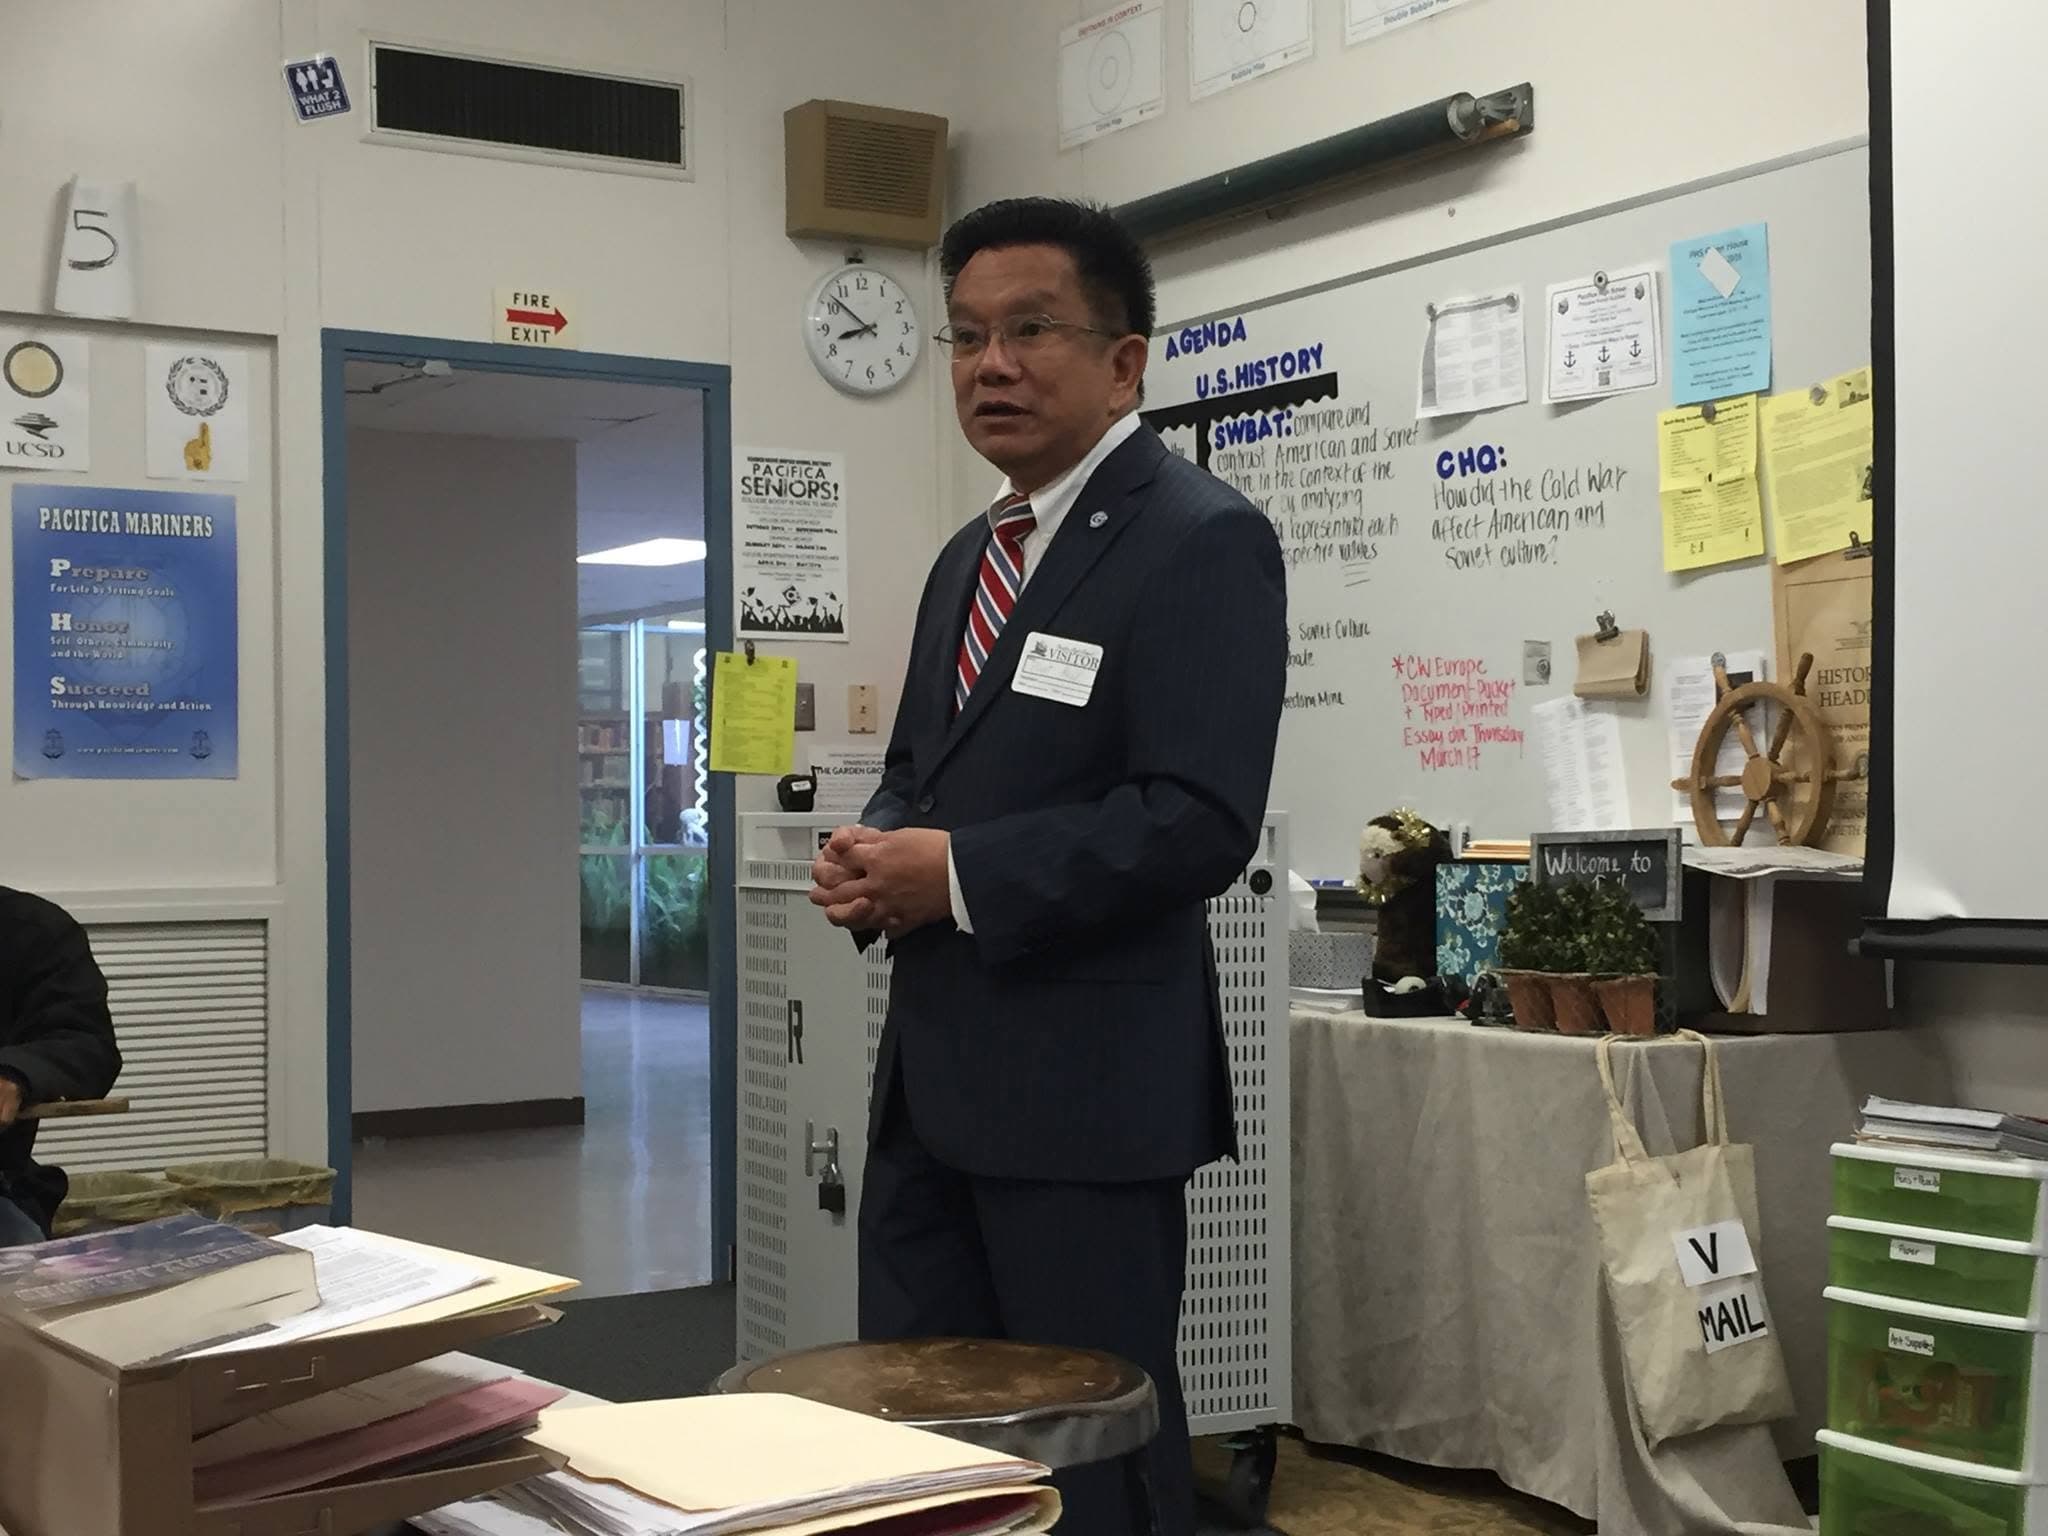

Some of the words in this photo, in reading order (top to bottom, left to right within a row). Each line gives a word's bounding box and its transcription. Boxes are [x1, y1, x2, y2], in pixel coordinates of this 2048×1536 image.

[298, 91, 330, 106] WHAT
[332, 90, 341, 100] 2
[305, 100, 342, 115] FLUSH
[68, 209, 119, 271] 5
[838, 284, 849, 298] 11
[856, 277, 869, 291] 12
[880, 284, 885, 298] 1
[513, 292, 551, 309] FIRE
[827, 301, 840, 316] 10
[895, 300, 903, 315] 2
[511, 326, 551, 343] EXIT
[821, 323, 831, 337] 9
[901, 321, 910, 336] 3
[1165, 316, 1247, 361] AGENDA
[828, 343, 838, 357] 8
[896, 342, 905, 356] 4
[845, 359, 854, 379] 7
[866, 364, 875, 380] 6
[883, 358, 893, 373] 5
[1215, 409, 1292, 451] SWBAT:
[1293, 410, 1345, 437] compare
[1345, 400, 1371, 426] and
[6, 439, 65, 459] UCSD
[1217, 445, 1266, 473] contrast
[1275, 438, 1347, 472] American
[1351, 427, 1377, 454] and
[752, 463, 826, 480] PACIFICA
[1436, 444, 1508, 480] CHQ:
[1259, 472, 1271, 490] in
[1275, 470, 1295, 490] the
[1299, 462, 1352, 489] context
[1352, 460, 1369, 484] of
[1372, 459, 1396, 481] the
[741, 476, 839, 502] SENIORS!
[1432, 478, 1468, 511] How
[1470, 477, 1496, 507] did
[1499, 476, 1534, 503] the
[1540, 467, 1581, 502] Cold
[1586, 461, 1629, 493] War
[39, 507, 121, 534] PACIFICA
[125, 511, 214, 538] MARINERS
[1367, 512, 1400, 538] each
[1431, 513, 1486, 543] affect
[1487, 505, 1570, 540] American
[1574, 499, 1606, 529] and
[1339, 539, 1378, 562] values
[1499, 533, 1559, 568] culture?
[50, 558, 150, 583] Prepare
[107, 584, 144, 597] Setting
[50, 612, 130, 634] Honor
[1048, 647, 1100, 669] VISITOR
[1435, 656, 1488, 681] Europe
[50, 676, 150, 696] Succeed
[1401, 681, 1475, 703] Document
[51, 699, 96, 711] Through
[98, 700, 155, 712] Knowledge
[158, 700, 177, 711] and
[179, 700, 212, 712] Action
[1403, 726, 1444, 747] Essay
[1468, 722, 1524, 746] Thursday
[1420, 746, 1463, 772] March
[1544, 845, 1622, 877] Welcome
[1630, 848, 1652, 873] to
[1688, 1231, 1719, 1275] V
[1698, 1293, 1767, 1343] MAIL
